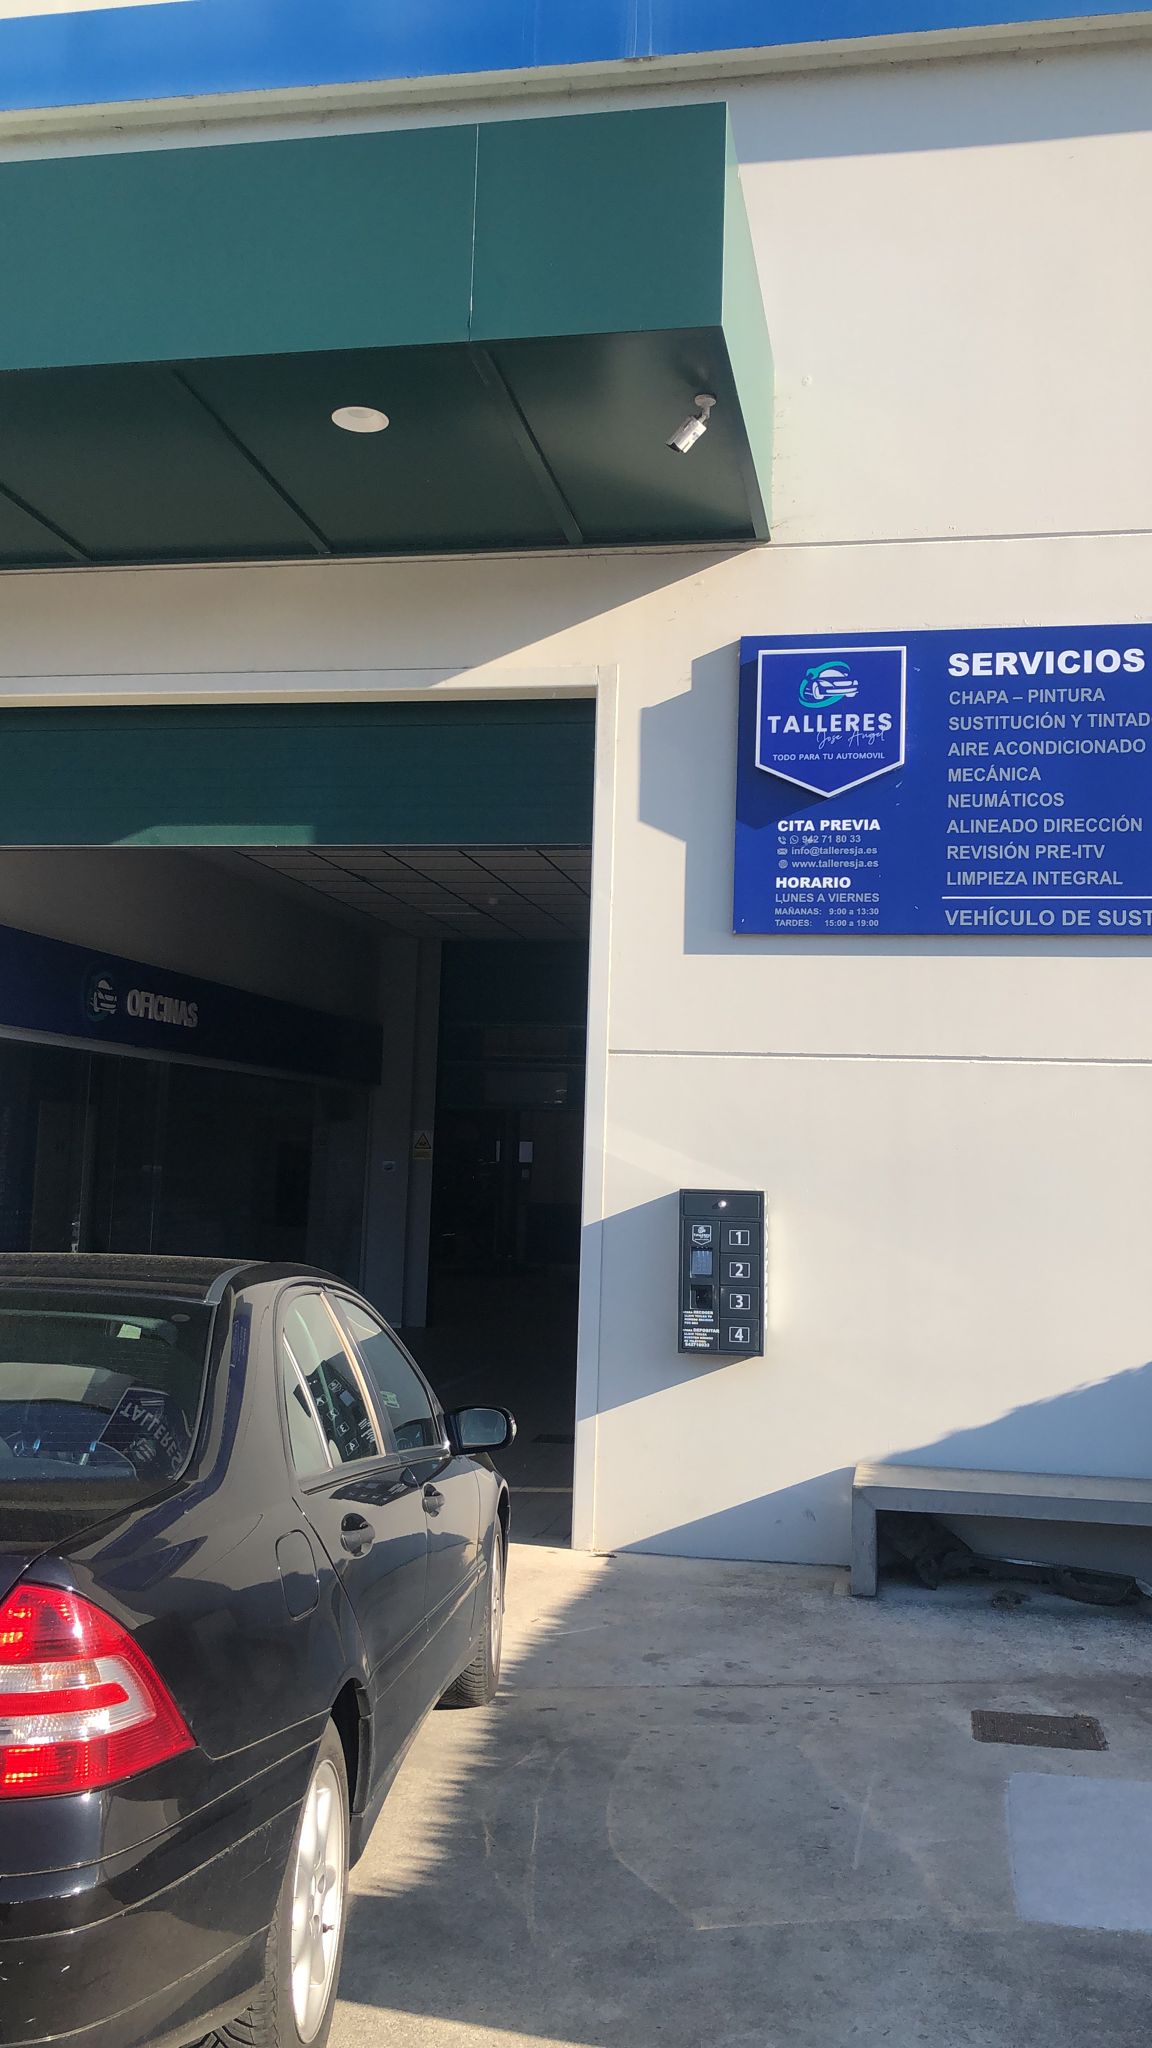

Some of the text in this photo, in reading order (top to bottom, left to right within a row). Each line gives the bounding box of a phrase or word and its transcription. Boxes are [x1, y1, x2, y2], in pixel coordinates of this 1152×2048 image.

[948, 648, 1146, 677] SERVICIOS
[949, 690, 1009, 705] CHAPA
[1028, 688, 1106, 703] PINTURA
[767, 713, 892, 734] TALLERES
[948, 712, 1152, 731] SUSTITUCIÓN Y TINTAD
[948, 738, 1146, 757] AIRE ACONDICIONADO
[799, 753, 820, 761] PARA
[836, 752, 885, 760] AUTOMOVIL
[948, 764, 1041, 782] MECÁNICA
[947, 790, 1065, 808] NEUMÁTICOS
[777, 819, 881, 832] CITA PREVIA
[946, 814, 1143, 834] ALINEADO DIRECCIÓN
[802, 835, 861, 844] 942 71 80 33
[791, 847, 877, 857] info@talleresja.es
[946, 842, 1105, 860] REVISIÓN PRE-ITV
[792, 860, 879, 869] www.talleresja.es
[775, 877, 851, 889] HORARIO
[946, 870, 1123, 886] LIMPIEZA INTEGRAL
[775, 893, 880, 903] LUNES A VIERNES
[774, 907, 822, 915] MAÑANAS:
[945, 906, 1152, 926] VEHÍCULO DE SUST
[774, 919, 812, 927] TARDES:
[825, 919, 846, 927] 15:00
[857, 919, 879, 927] 19:00
[127, 989, 199, 1028] OFICINAS
[735, 1231, 742, 1244] 1
[735, 1263, 744, 1277] 2
[735, 1295, 744, 1308] 3
[734, 1328, 744, 1342] 4
